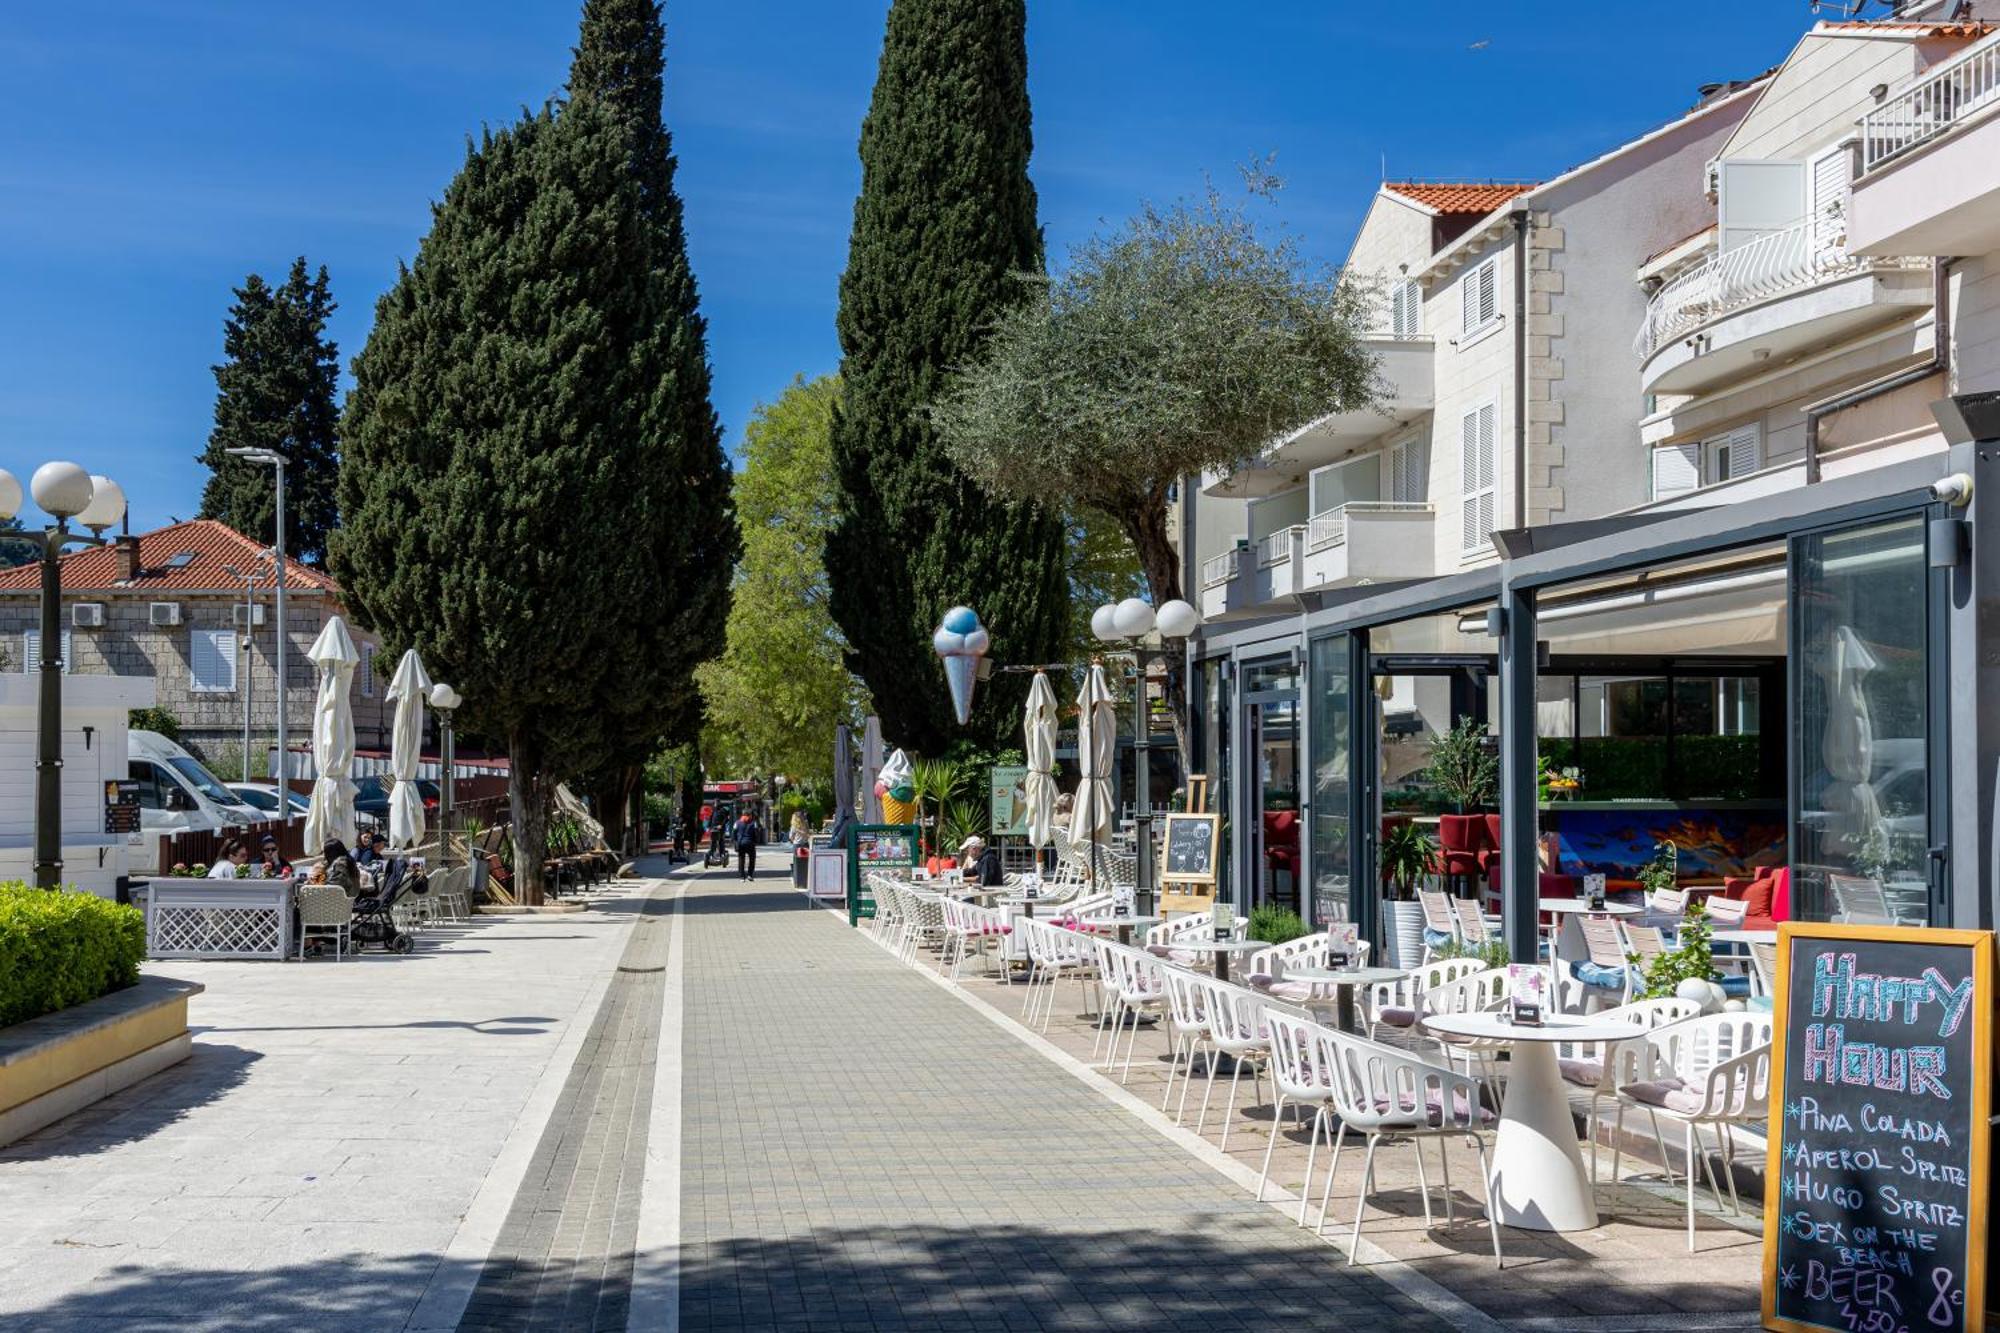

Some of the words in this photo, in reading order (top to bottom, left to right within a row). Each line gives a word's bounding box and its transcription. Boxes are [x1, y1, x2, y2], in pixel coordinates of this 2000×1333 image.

[1812, 952, 1973, 1037] HAPPY
[1804, 1023, 1952, 1099] HOUR
[1861, 1103, 1951, 1147] COLADA
[1795, 1140, 1893, 1171] APEROL
[1901, 1146, 1967, 1187] SPRITZ
[1794, 1171, 1863, 1209] HUGO
[1879, 1185, 1964, 1227] SPRITZ
[1794, 1211, 1847, 1244] SEX
[1853, 1226, 1879, 1244] ON
[1884, 1228, 1938, 1251] THE
[1835, 1245, 1913, 1277] BEACH
[1803, 1259, 1902, 1315] BEER
